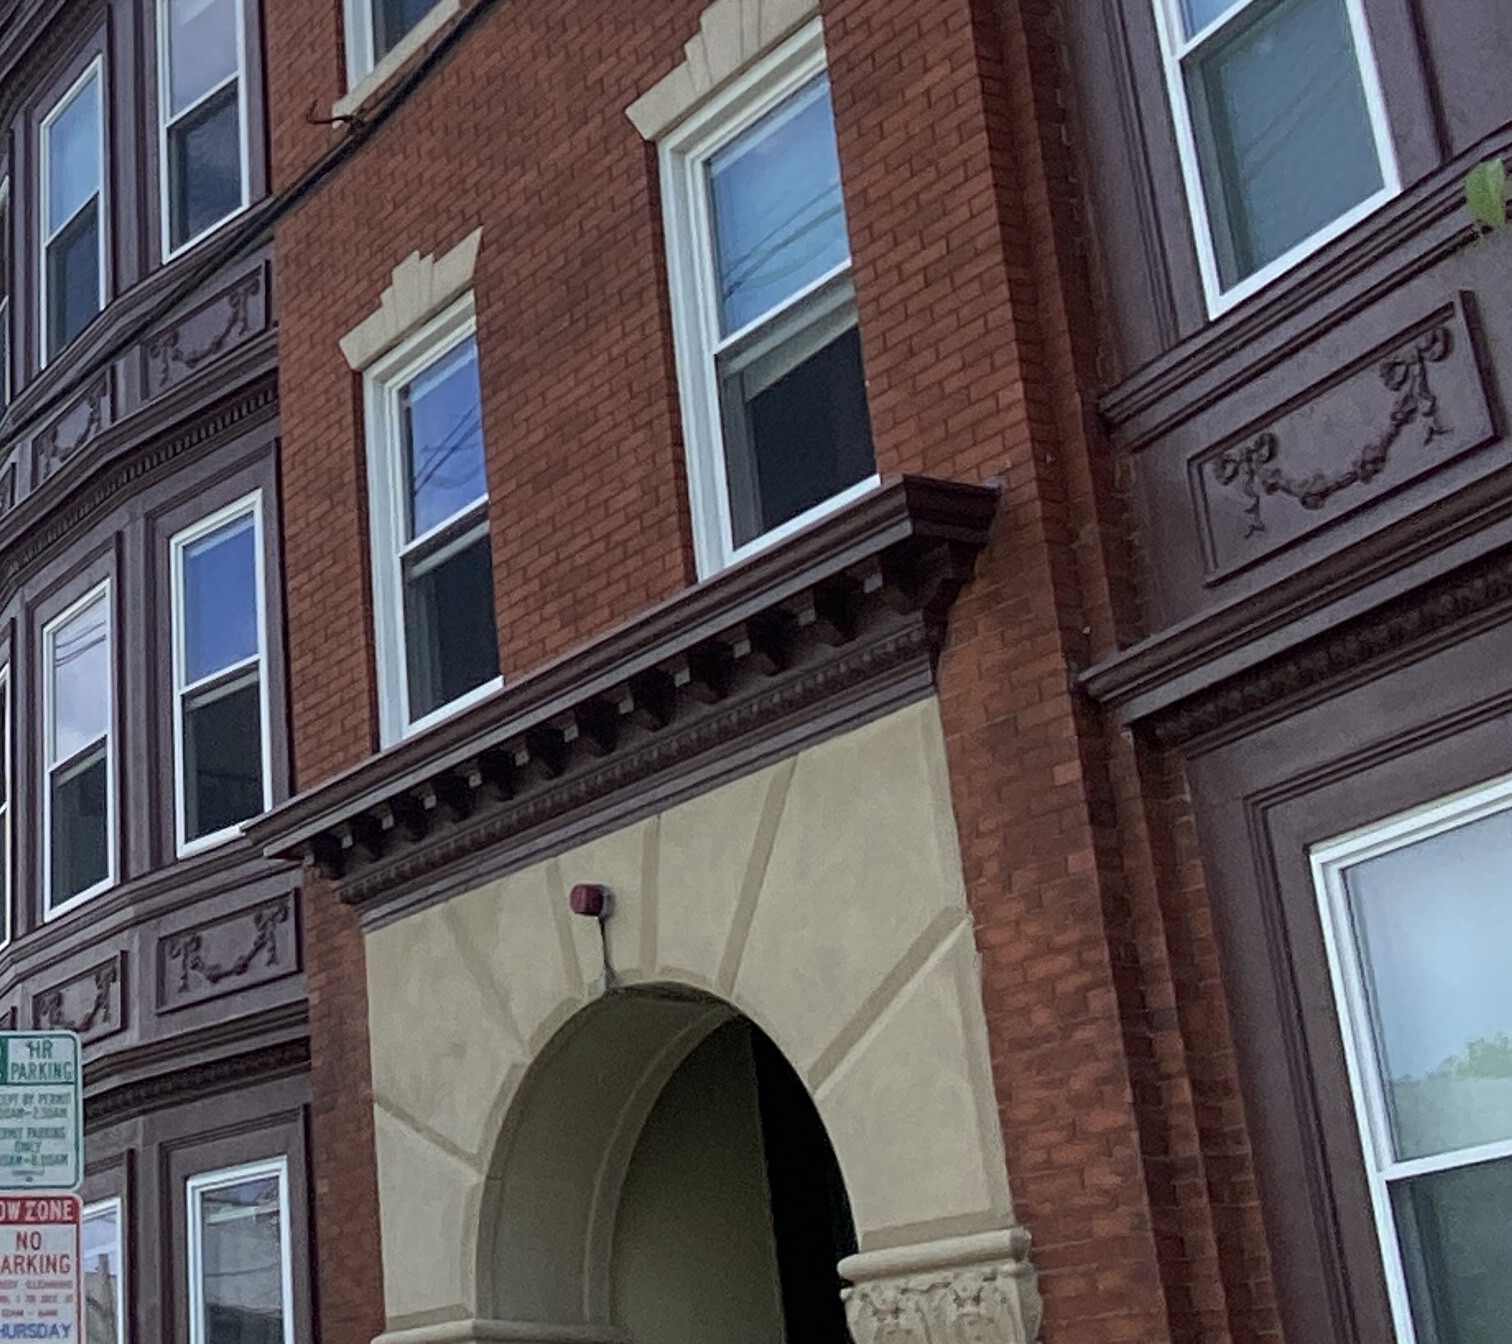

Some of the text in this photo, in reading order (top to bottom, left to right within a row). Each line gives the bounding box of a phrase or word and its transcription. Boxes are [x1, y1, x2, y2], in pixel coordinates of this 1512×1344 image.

[27, 1040, 54, 1059] HR
[11, 1061, 72, 1080] PARKING
[24, 1200, 73, 1222] ZONE
[16, 1231, 42, 1251] NO
